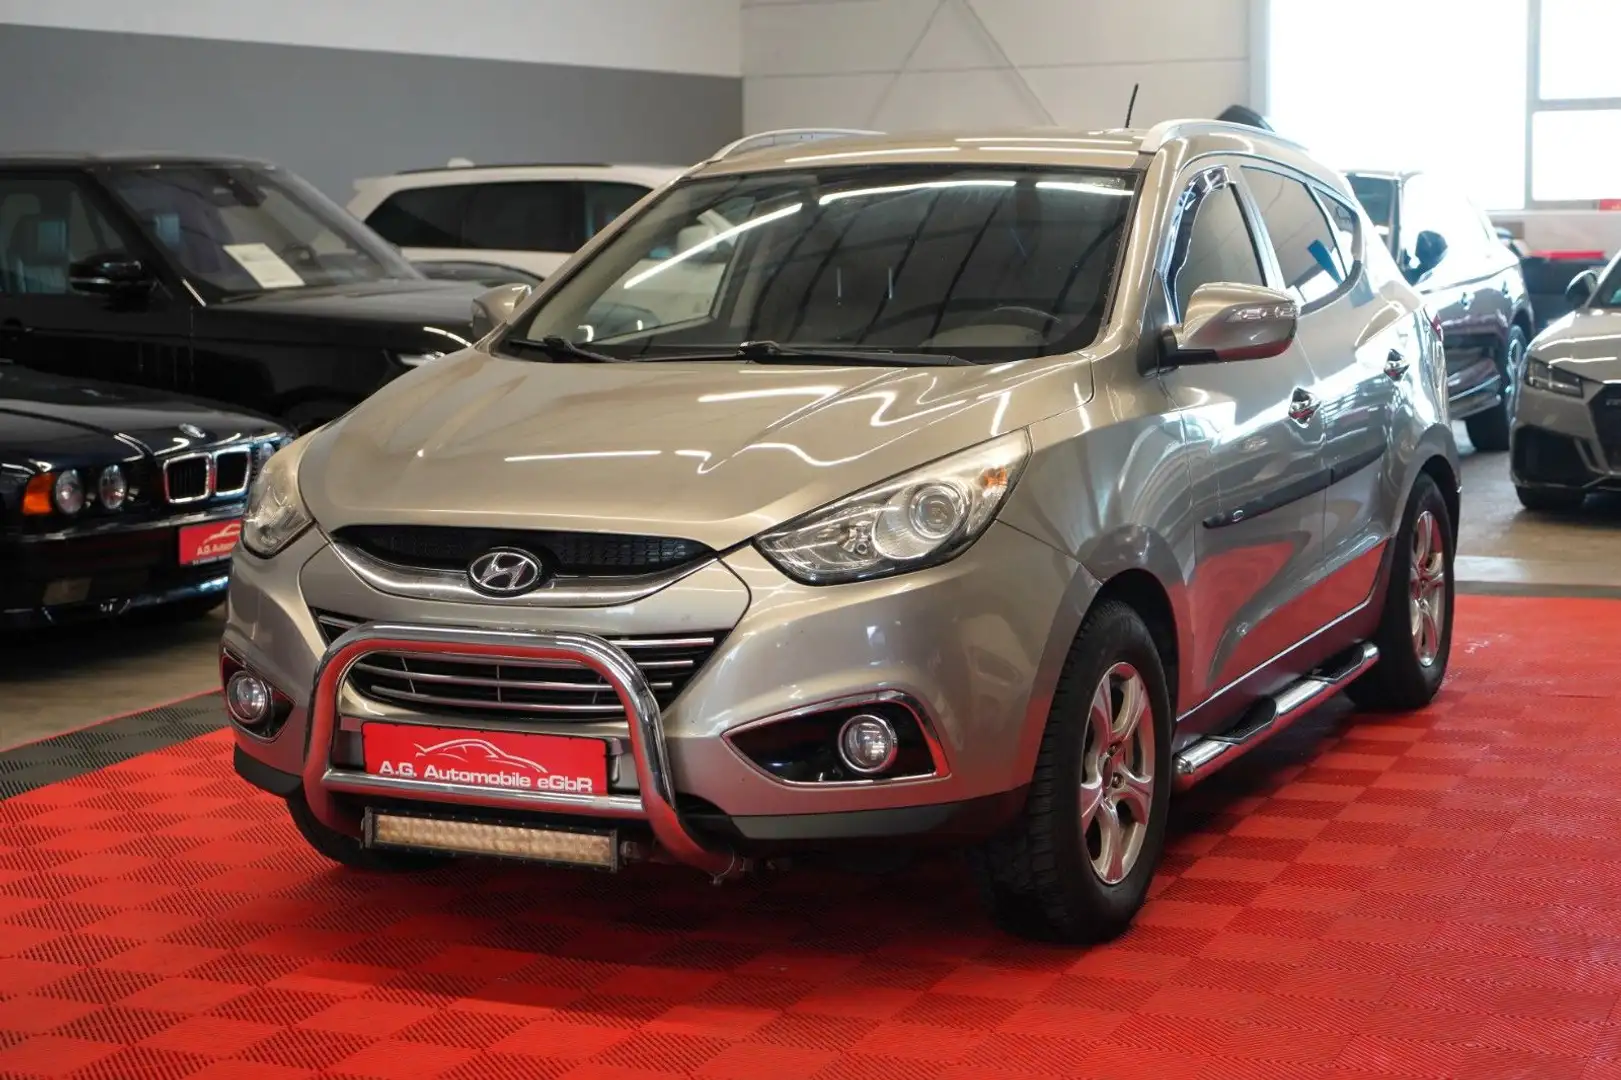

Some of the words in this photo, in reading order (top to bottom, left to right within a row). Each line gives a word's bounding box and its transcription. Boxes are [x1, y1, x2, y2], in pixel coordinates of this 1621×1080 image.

[379, 760, 418, 778] A.G.
[423, 764, 532, 788] Automobile
[537, 774, 593, 793] eGbR
